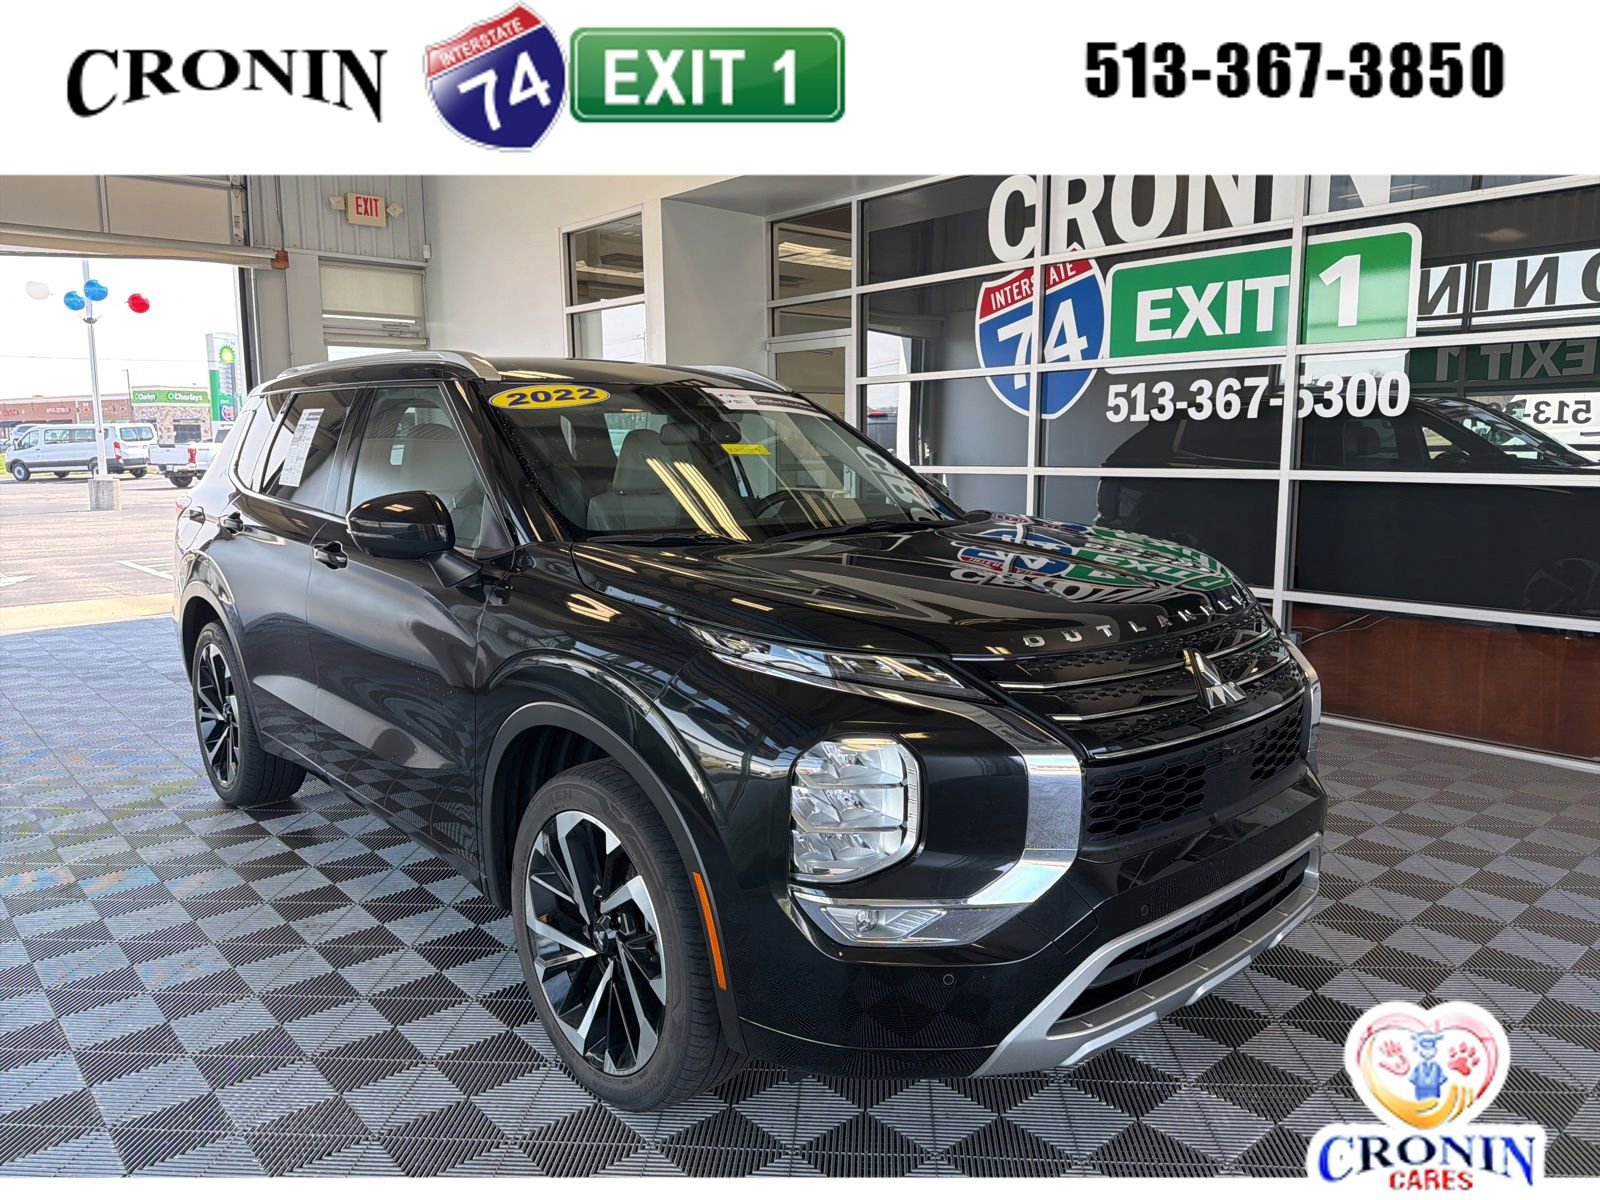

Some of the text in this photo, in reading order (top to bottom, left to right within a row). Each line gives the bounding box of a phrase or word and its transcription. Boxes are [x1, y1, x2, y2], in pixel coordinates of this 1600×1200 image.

[355, 196, 380, 217] EXIT
[990, 262, 1077, 310] INTERATE
[1135, 254, 1361, 342] EXIT 1
[996, 298, 1088, 390] 74
[506, 388, 599, 406] 2022
